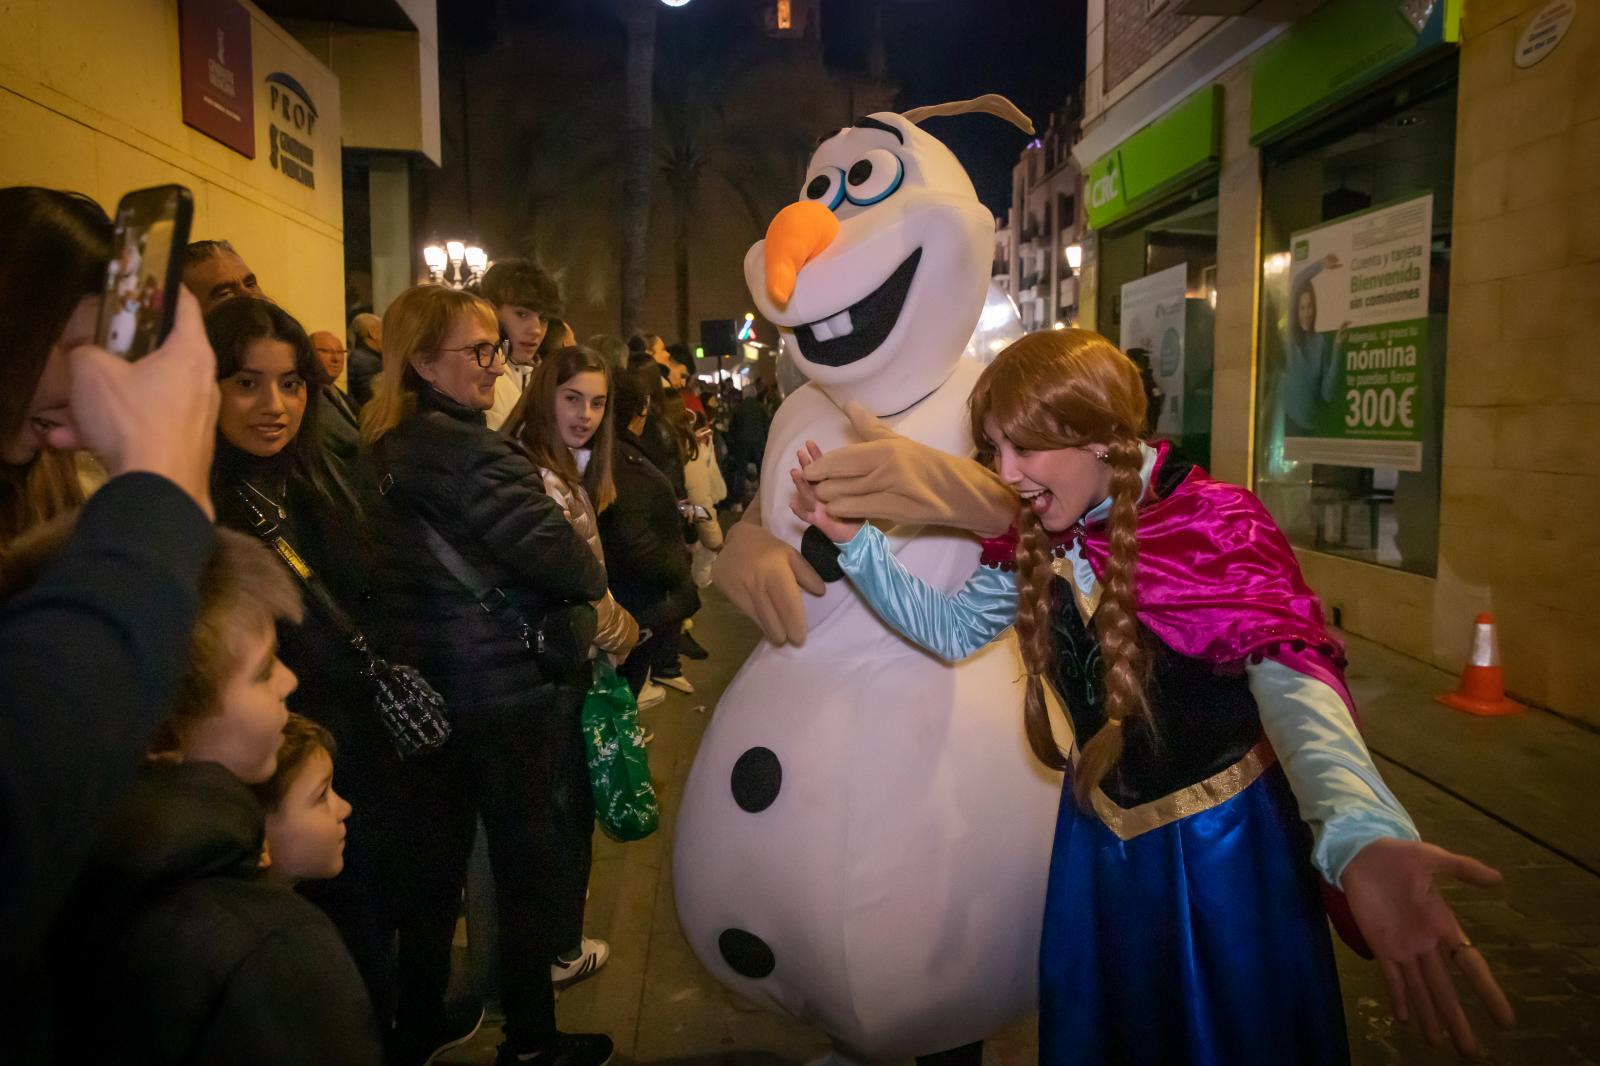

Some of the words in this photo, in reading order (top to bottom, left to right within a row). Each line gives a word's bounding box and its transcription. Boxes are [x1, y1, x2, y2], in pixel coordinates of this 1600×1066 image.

[1351, 255, 1381, 271] Cuenta
[1391, 245, 1422, 263] tarjeta
[1350, 263, 1421, 293] Bienvenida
[1350, 296, 1363, 309] sin
[1365, 288, 1420, 306] comisiones
[1346, 340, 1416, 371] nómina
